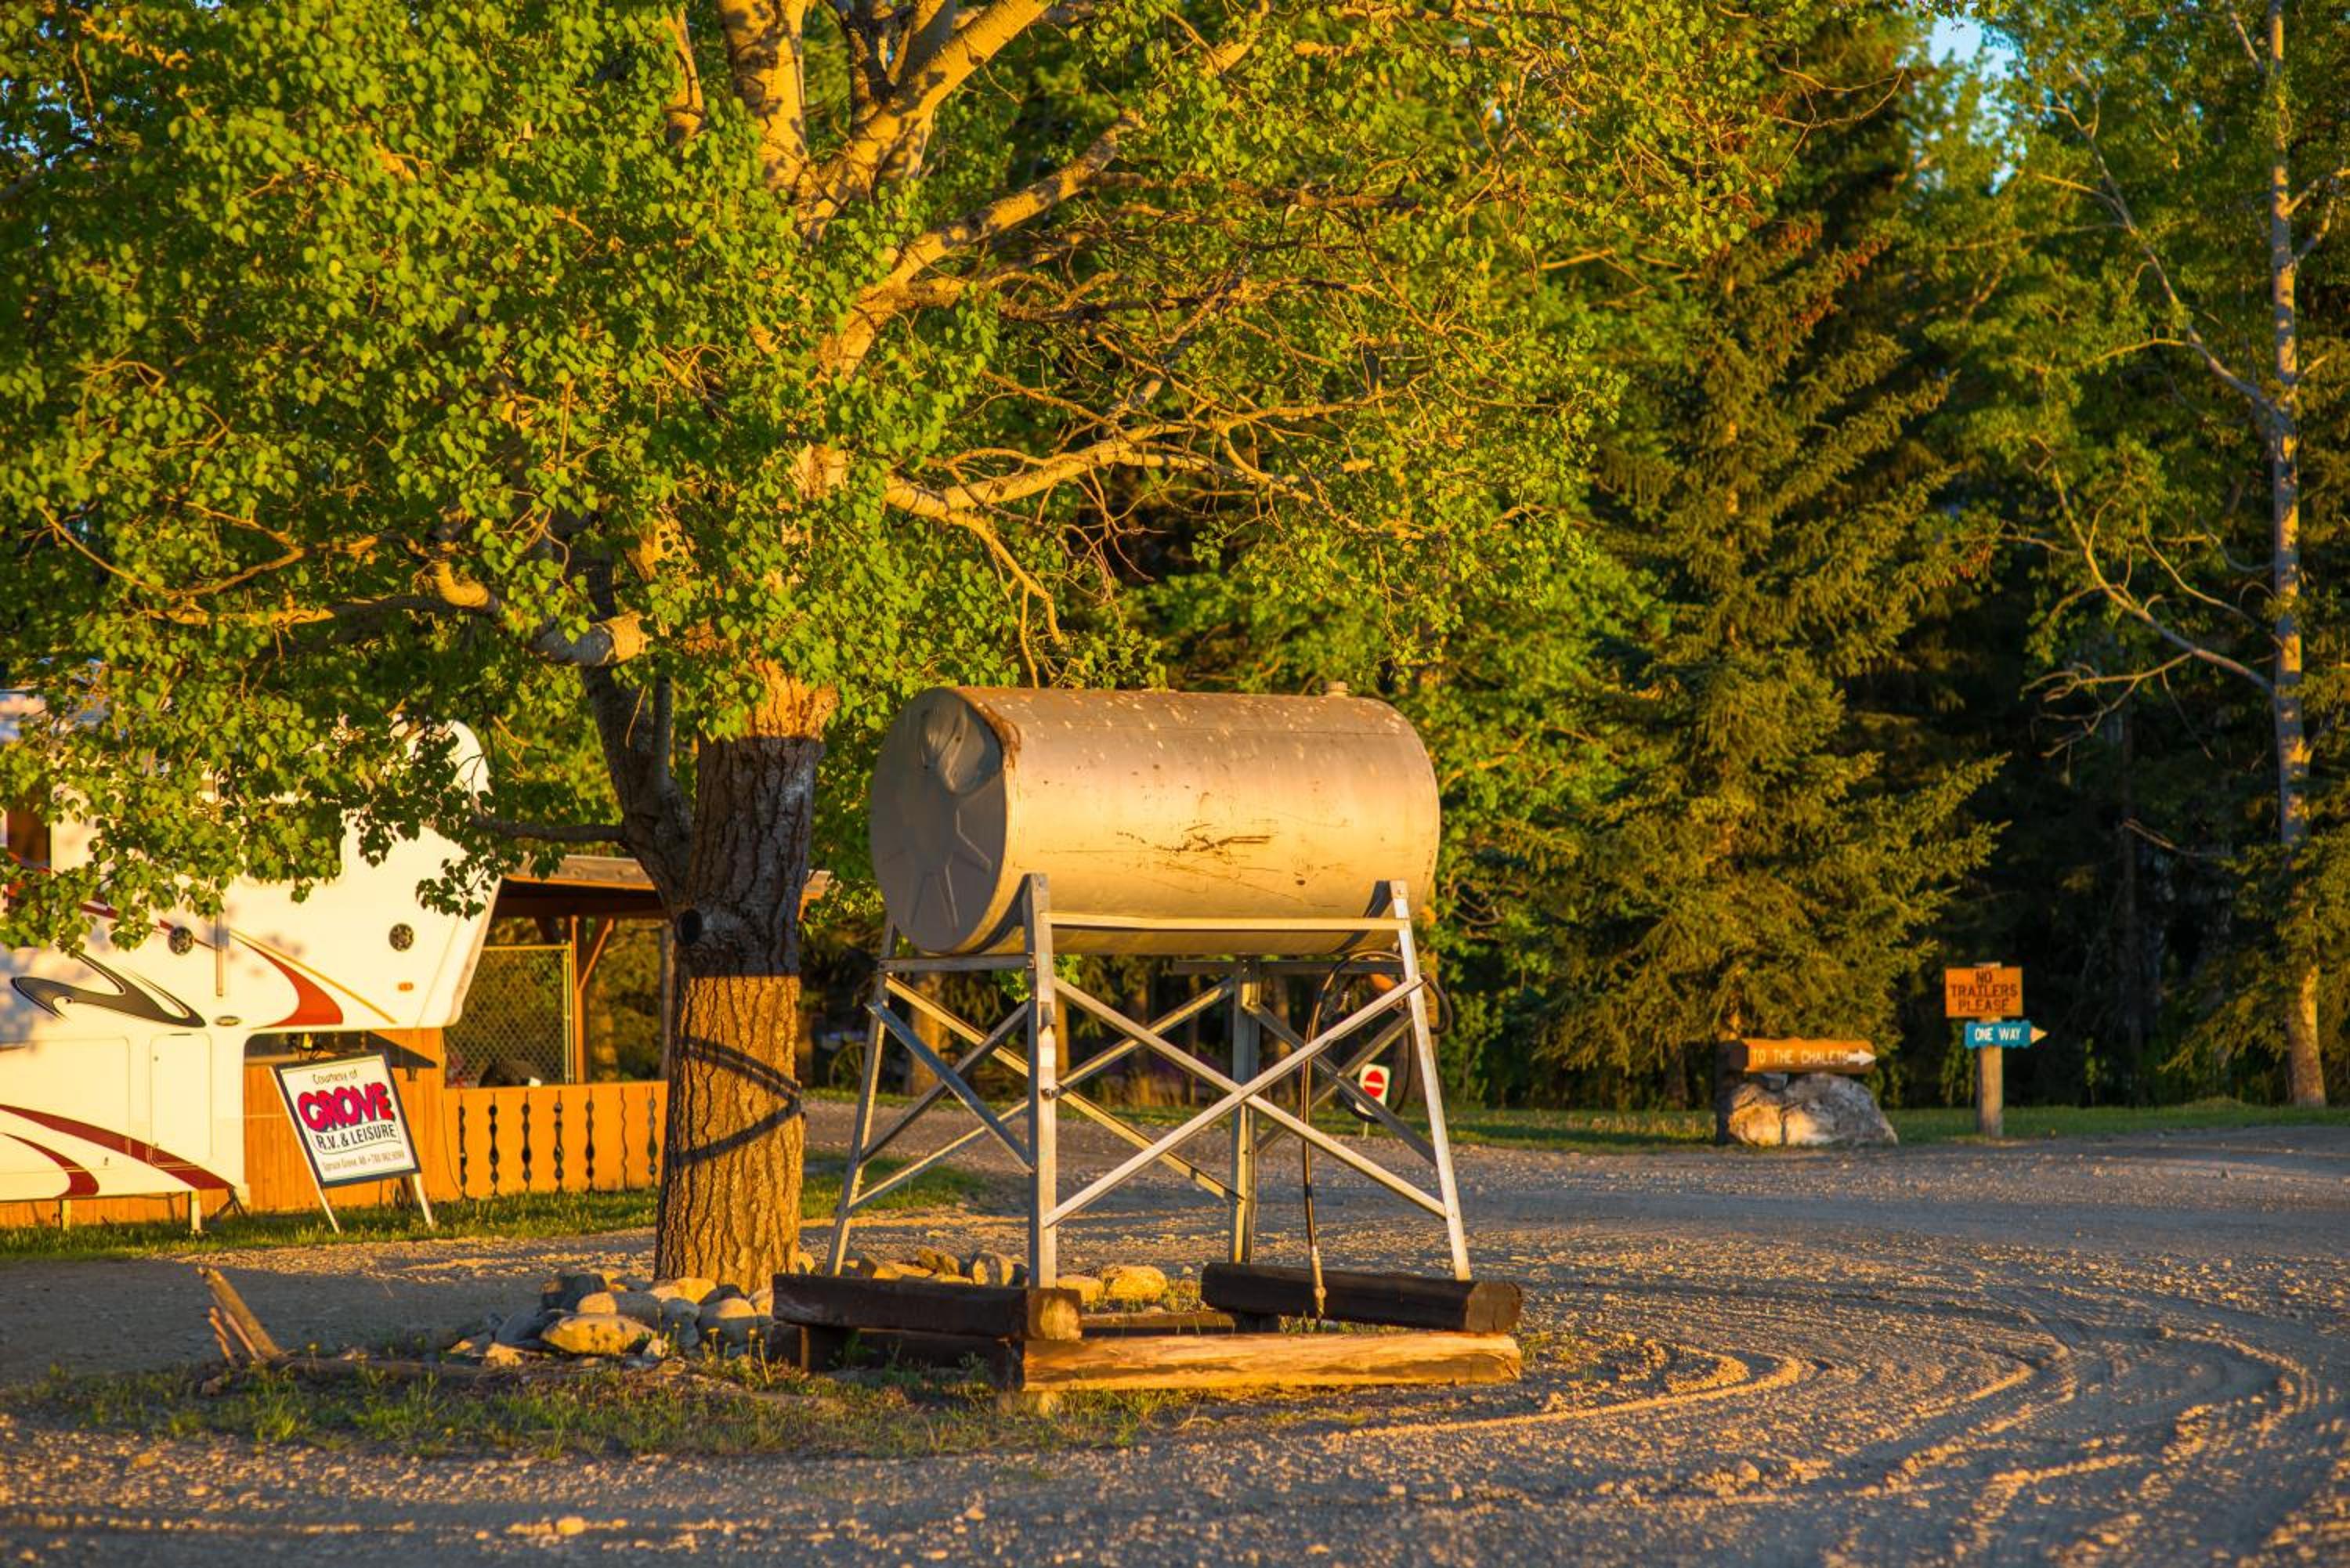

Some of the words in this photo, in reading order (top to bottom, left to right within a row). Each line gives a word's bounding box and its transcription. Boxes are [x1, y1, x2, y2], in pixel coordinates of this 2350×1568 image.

[1976, 971, 1993, 985] NO
[1950, 983, 2018, 998] TRAILERS
[1958, 998, 2009, 1013] PLEASE
[1975, 1027, 1993, 1041] ONE
[1998, 1027, 2022, 1041] WAY
[1752, 1049, 1766, 1064] TO
[1773, 1049, 1794, 1064] THE
[1801, 1050, 1849, 1066] CHALETS
[313, 1071, 347, 1085] Courtesy
[349, 1068, 358, 1079] of
[298, 1082, 396, 1133] GROVE
[316, 1135, 340, 1150] R.V.
[340, 1133, 349, 1147] &
[350, 1124, 396, 1144] LEISURE
